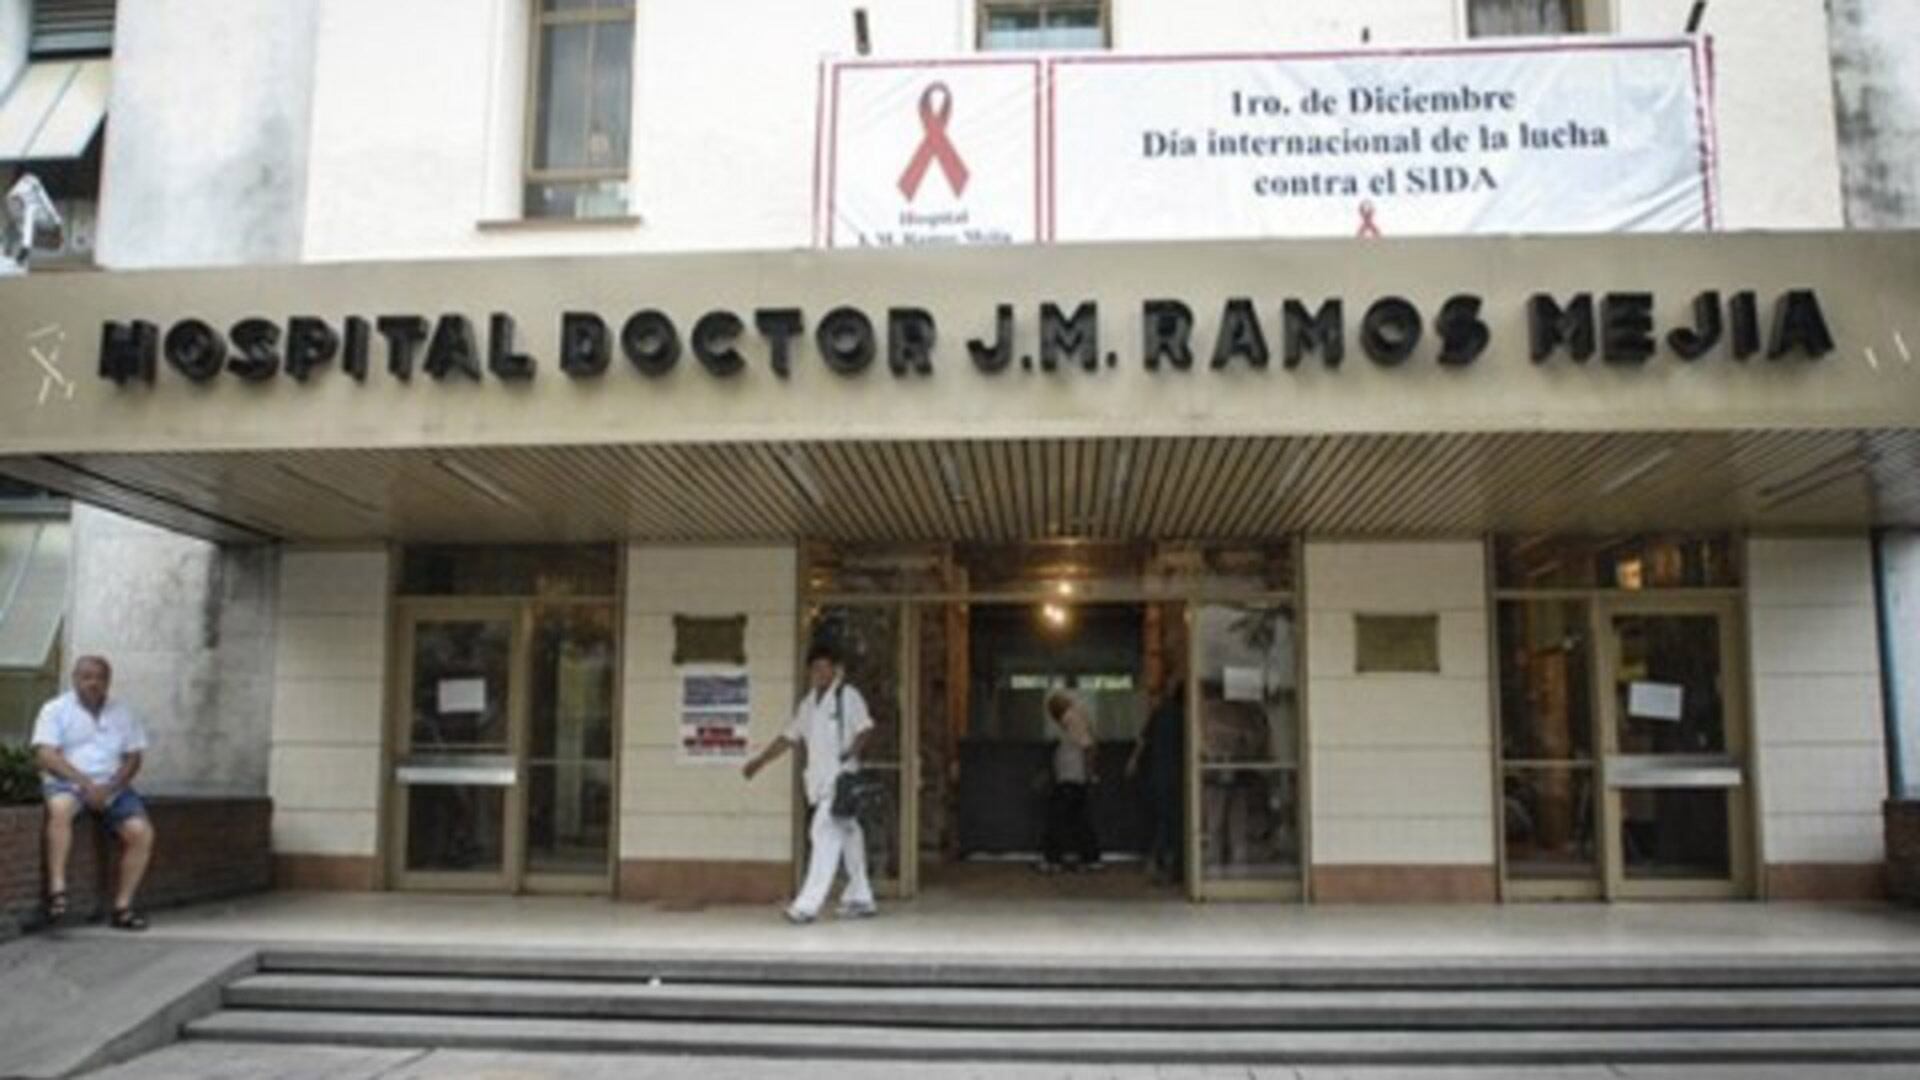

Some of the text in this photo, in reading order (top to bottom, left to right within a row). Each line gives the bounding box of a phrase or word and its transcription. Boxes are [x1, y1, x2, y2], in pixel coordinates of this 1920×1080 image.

[1233, 86, 1514, 116] 1ro. de Diciembre
[1208, 127, 1421, 156] internacional
[1431, 126, 1468, 152] de
[1479, 125, 1508, 151] la
[1520, 121, 1608, 148] lucha
[1254, 167, 1497, 195] contra el SIDA
[98, 289, 1835, 385] HOSPITAL DOCTOR J.M. RAMOS MEJIA
